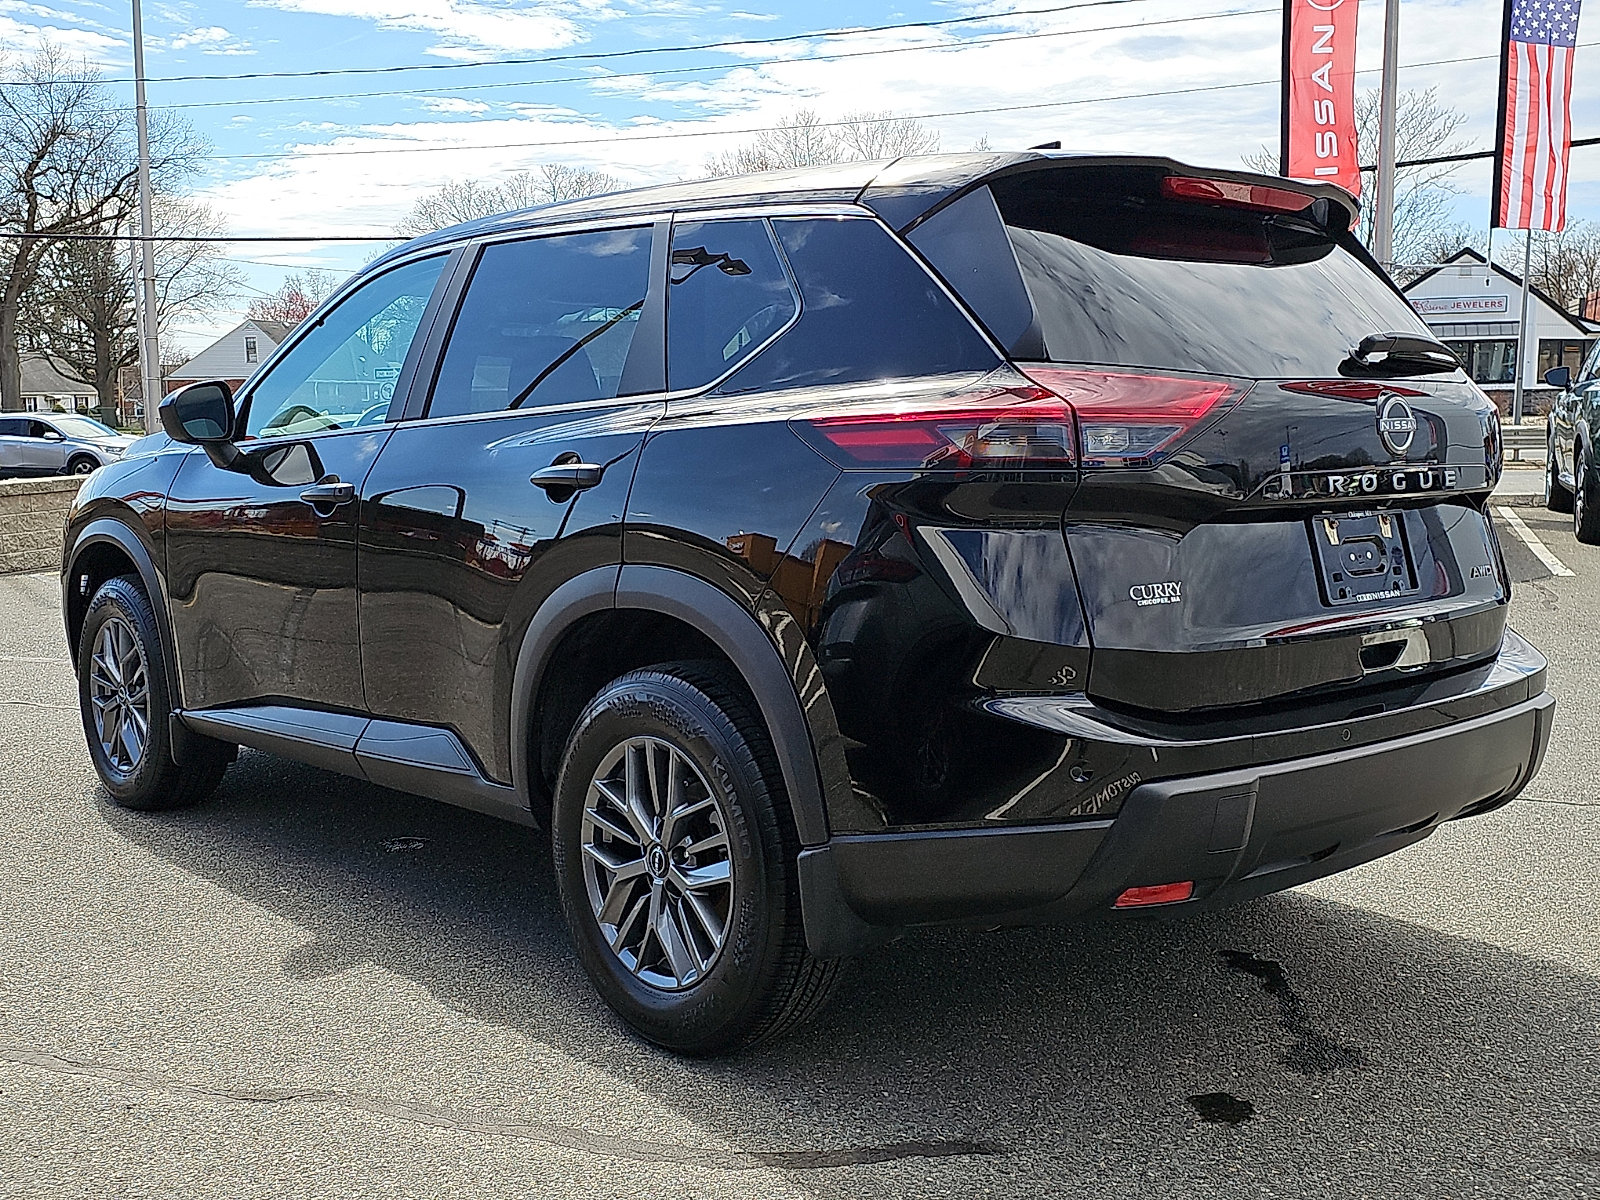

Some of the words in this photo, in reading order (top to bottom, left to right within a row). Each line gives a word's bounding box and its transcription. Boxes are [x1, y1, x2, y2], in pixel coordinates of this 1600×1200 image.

[1311, 24, 1340, 176] ISSAN
[1451, 300, 1503, 309] JEWELERS
[1380, 419, 1417, 431] NISSAN
[1327, 470, 1457, 493] ROGUE
[1130, 581, 1182, 600] CURRY
[712, 755, 752, 859] KUMHO
